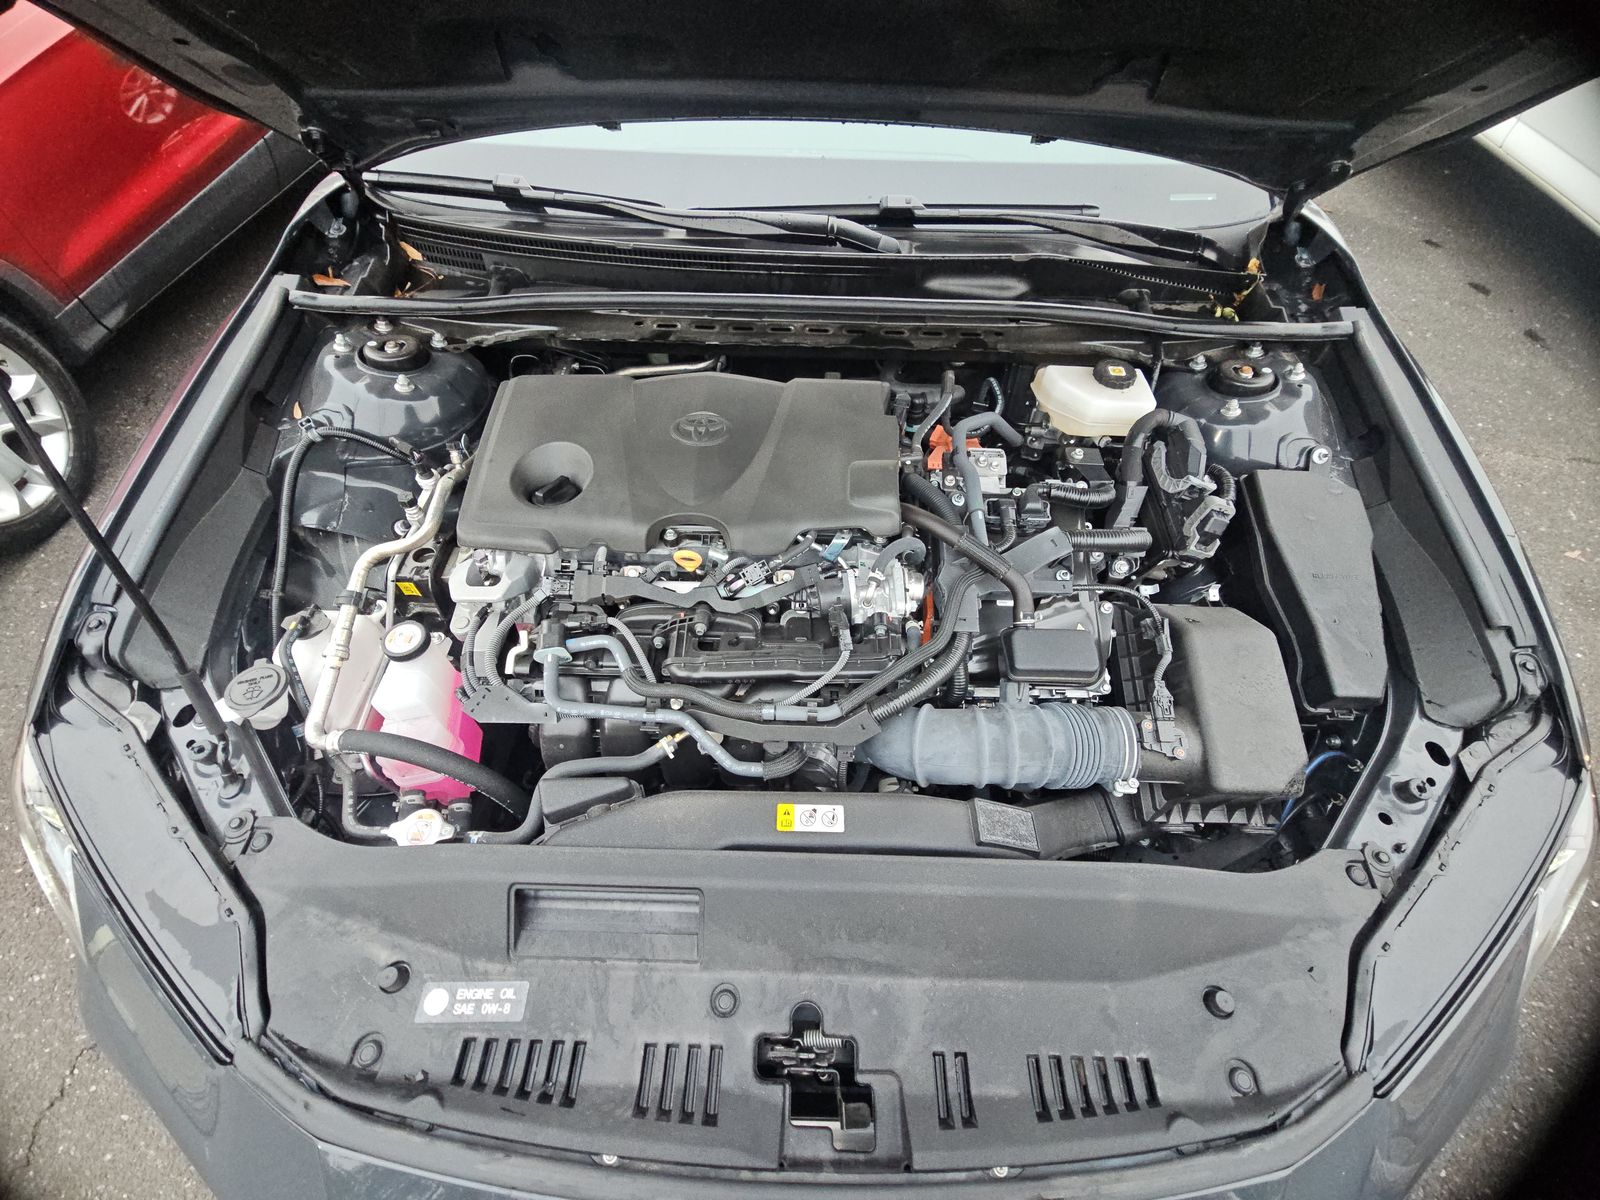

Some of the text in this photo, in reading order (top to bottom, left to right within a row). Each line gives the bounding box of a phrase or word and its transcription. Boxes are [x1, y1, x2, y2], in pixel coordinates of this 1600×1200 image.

[456, 987, 516, 1000] ENGINE OIL
[453, 1002, 511, 1015] SAE 0W-8
